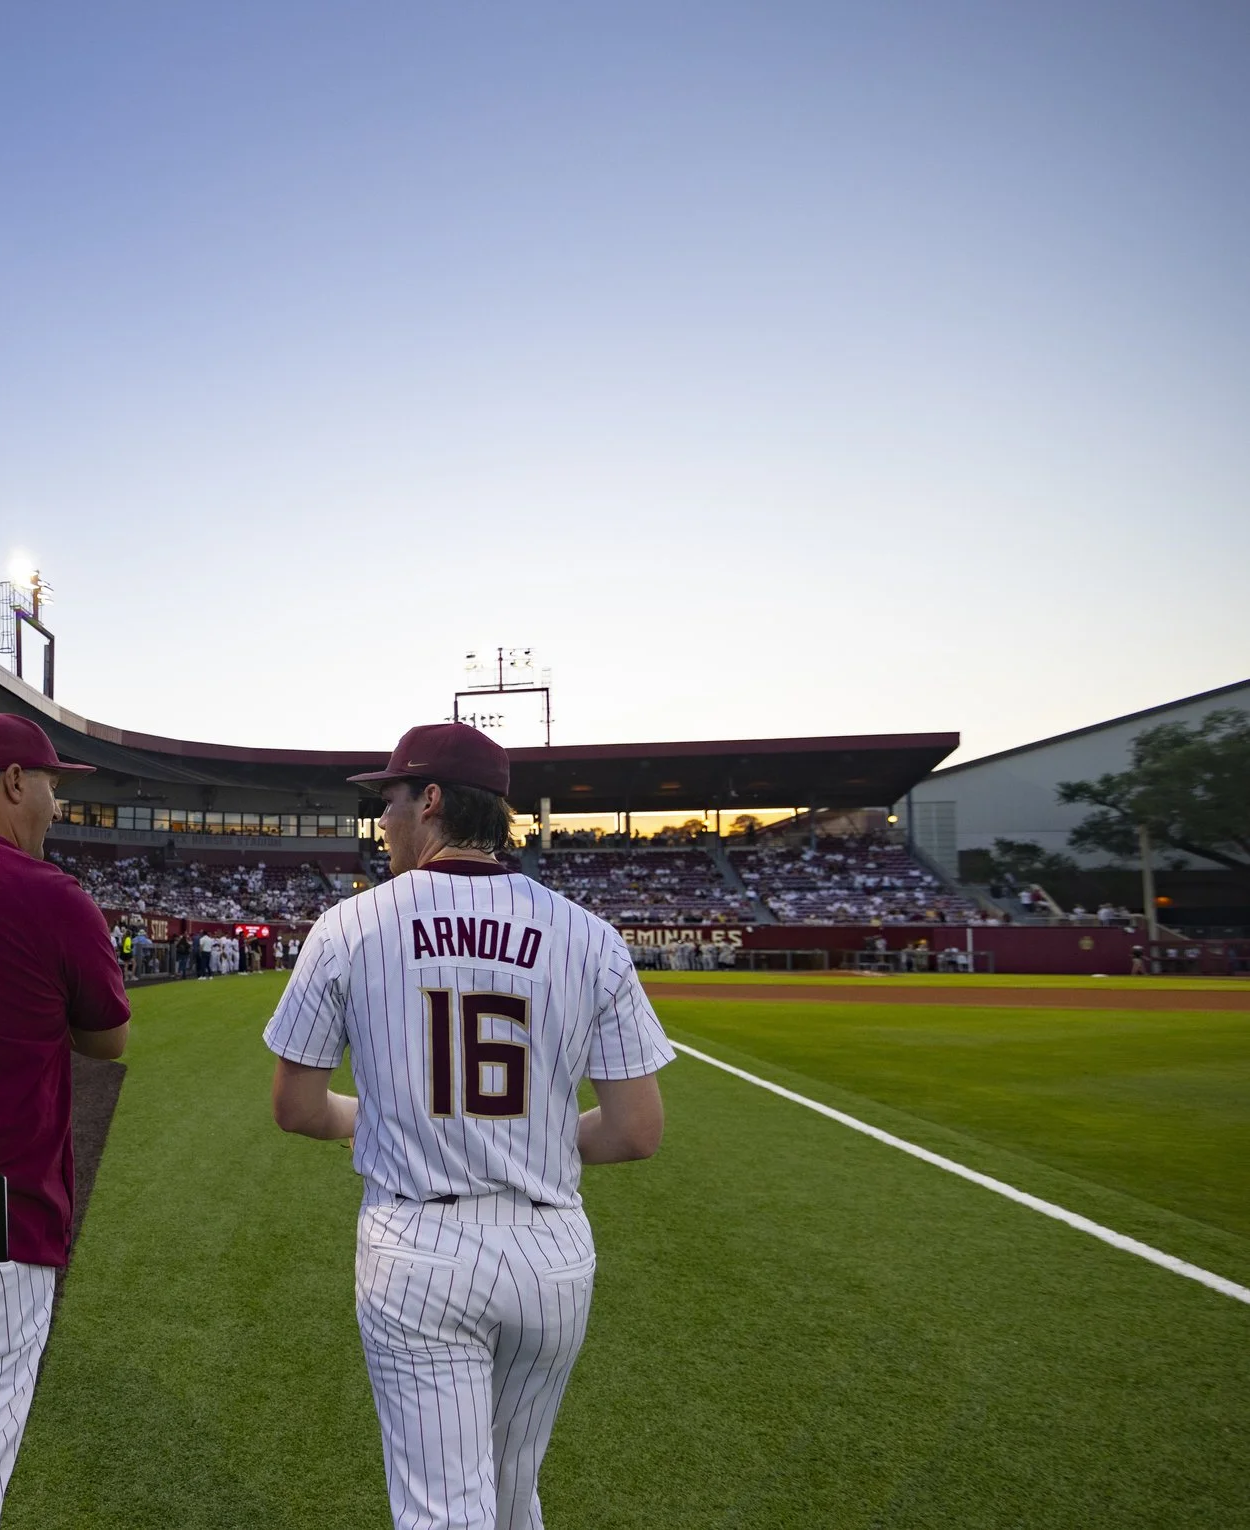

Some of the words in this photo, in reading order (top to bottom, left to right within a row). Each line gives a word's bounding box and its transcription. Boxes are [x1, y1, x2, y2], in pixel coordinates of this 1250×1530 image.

[151, 919, 169, 941] STATE
[412, 916, 543, 969] ARNOLD
[622, 929, 744, 948] EMINOLES
[417, 987, 531, 1121] 16
